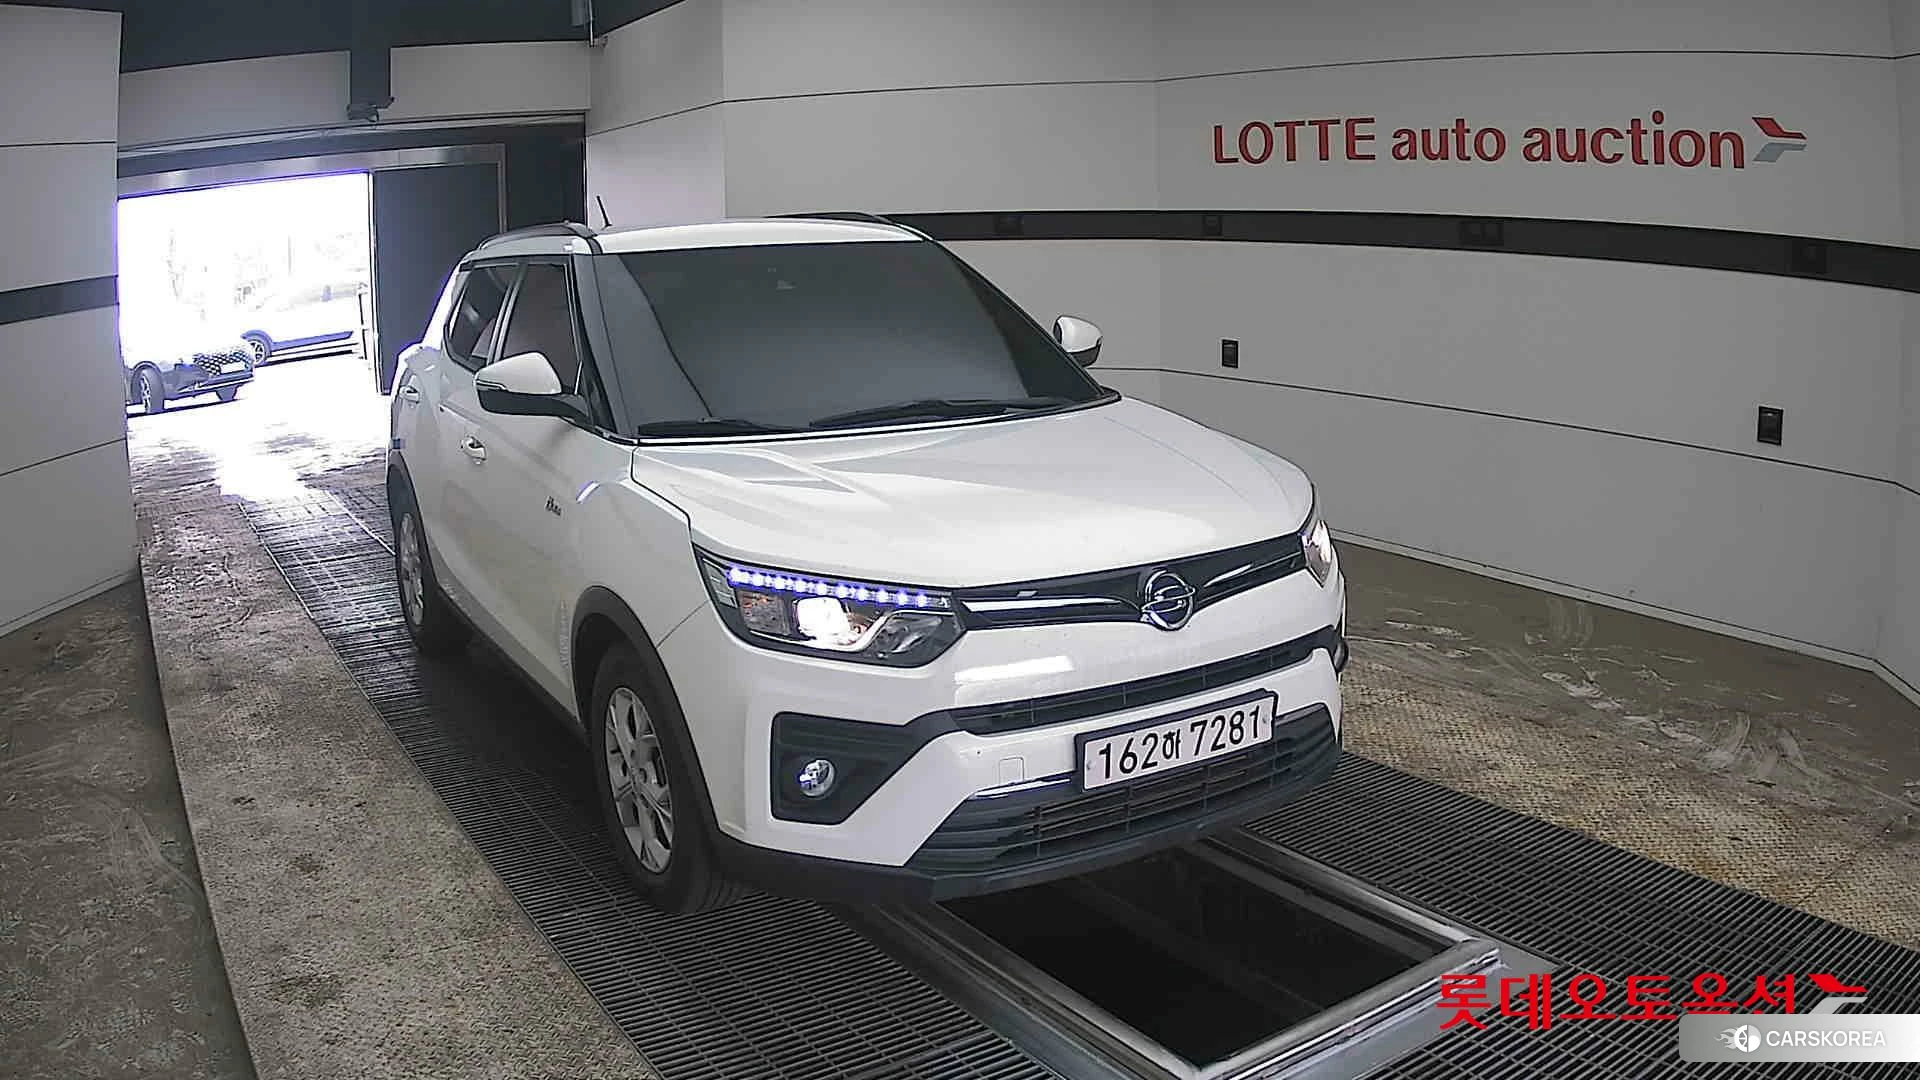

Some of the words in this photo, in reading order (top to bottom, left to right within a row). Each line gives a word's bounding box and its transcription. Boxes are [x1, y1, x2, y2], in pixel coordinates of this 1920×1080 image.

[1213, 117, 1376, 164] LOTTE
[1391, 118, 1507, 162] auto
[1522, 110, 1746, 169] auction
[1098, 728, 1182, 779] 162하
[1190, 705, 1260, 757] 7281
